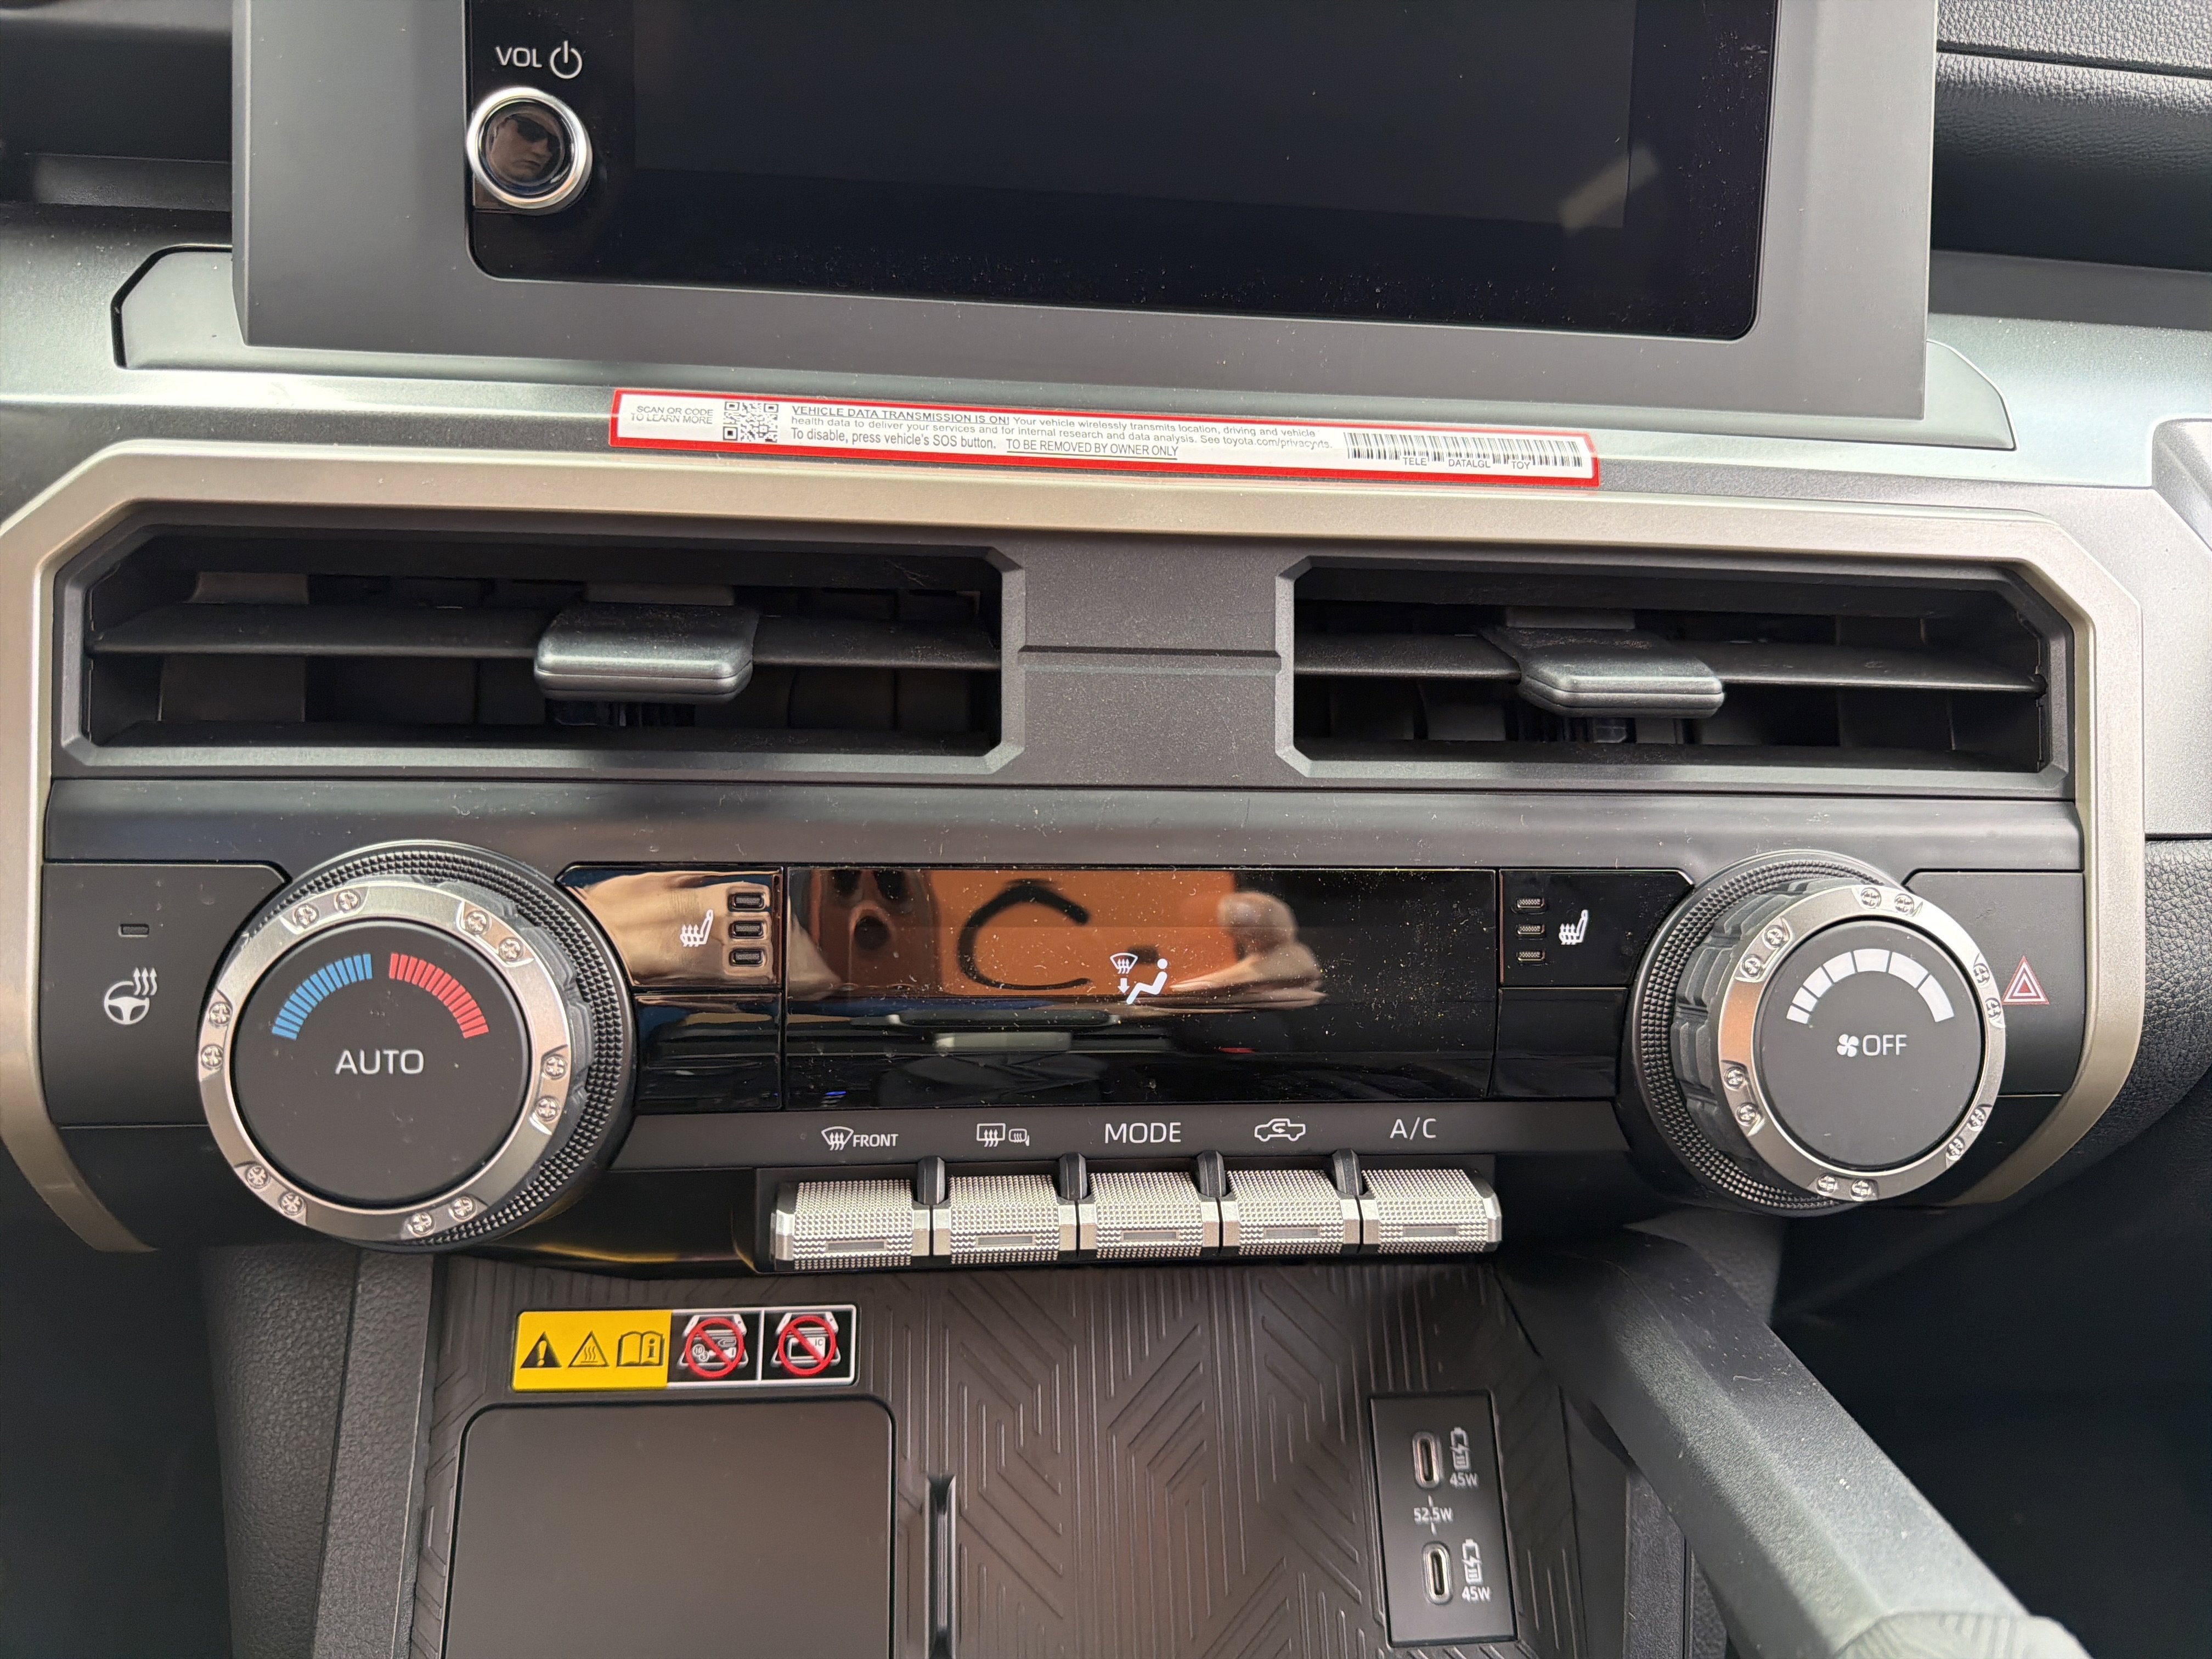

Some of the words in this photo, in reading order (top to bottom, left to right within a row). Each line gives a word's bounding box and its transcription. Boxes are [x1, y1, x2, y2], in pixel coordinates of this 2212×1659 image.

[495, 46, 543, 68] VOL
[631, 413, 644, 421] TO
[646, 414, 680, 422] LEARN
[682, 415, 713, 425] MORE
[636, 405, 665, 414] SCAN
[684, 408, 714, 416] CODE
[792, 406, 844, 416] VEHICLE
[848, 408, 878, 418] DATA
[883, 410, 971, 422] TRANSMISSION
[975, 415, 985, 424] IS
[989, 415, 1009, 425] ON!
[1013, 416, 1036, 426] Your
[1039, 418, 1075, 427] vehicle
[1078, 420, 1127, 431] wirelessly
[1130, 422, 1176, 432] transmits
[1178, 424, 1221, 435] location,
[1223, 426, 1256, 437] driving
[1259, 427, 1278, 436] and
[1280, 428, 1316, 437] vehicle
[791, 416, 823, 426] health
[827, 418, 850, 427] data
[854, 419, 865, 428] to
[868, 420, 903, 430] deliver
[907, 424, 930, 432] your
[933, 424, 975, 433] services
[979, 425, 997, 434] and
[1001, 426, 1014, 435] for
[1018, 427, 1056, 437] internal
[1059, 430, 1104, 439] research
[1107, 431, 1125, 440] and
[1128, 432, 1150, 441] data
[1154, 433, 1197, 445] analysis.
[1200, 435, 1220, 444] See
[791, 427, 804, 439] To
[807, 428, 848, 444] disable,
[852, 432, 881, 445] press
[884, 432, 929, 446] vehicle's
[933, 434, 957, 447] SOS
[961, 436, 997, 449] button.
[1006, 438, 1020, 449] TO
[1023, 439, 1037, 450] BE
[1040, 440, 1092, 453] REMOVED
[1094, 442, 1108, 454] BY
[1110, 442, 1149, 455] OWNER
[1152, 444, 1178, 457] ONLY
[1402, 456, 1427, 466] TELE
[1448, 459, 1491, 469] DATALGL
[1511, 460, 1531, 470] TOY
[1862, 1034, 1908, 1056] OFF
[335, 1049, 424, 1075] AUTO
[1105, 1121, 1182, 1144] MODE
[1390, 1116, 1437, 1141] A/C
[853, 1133, 899, 1148] FRONT
[1449, 1472, 1480, 1488] 45W
[1413, 1506, 1453, 1524] 52.5W
[1462, 1585, 1492, 1601] 45W
